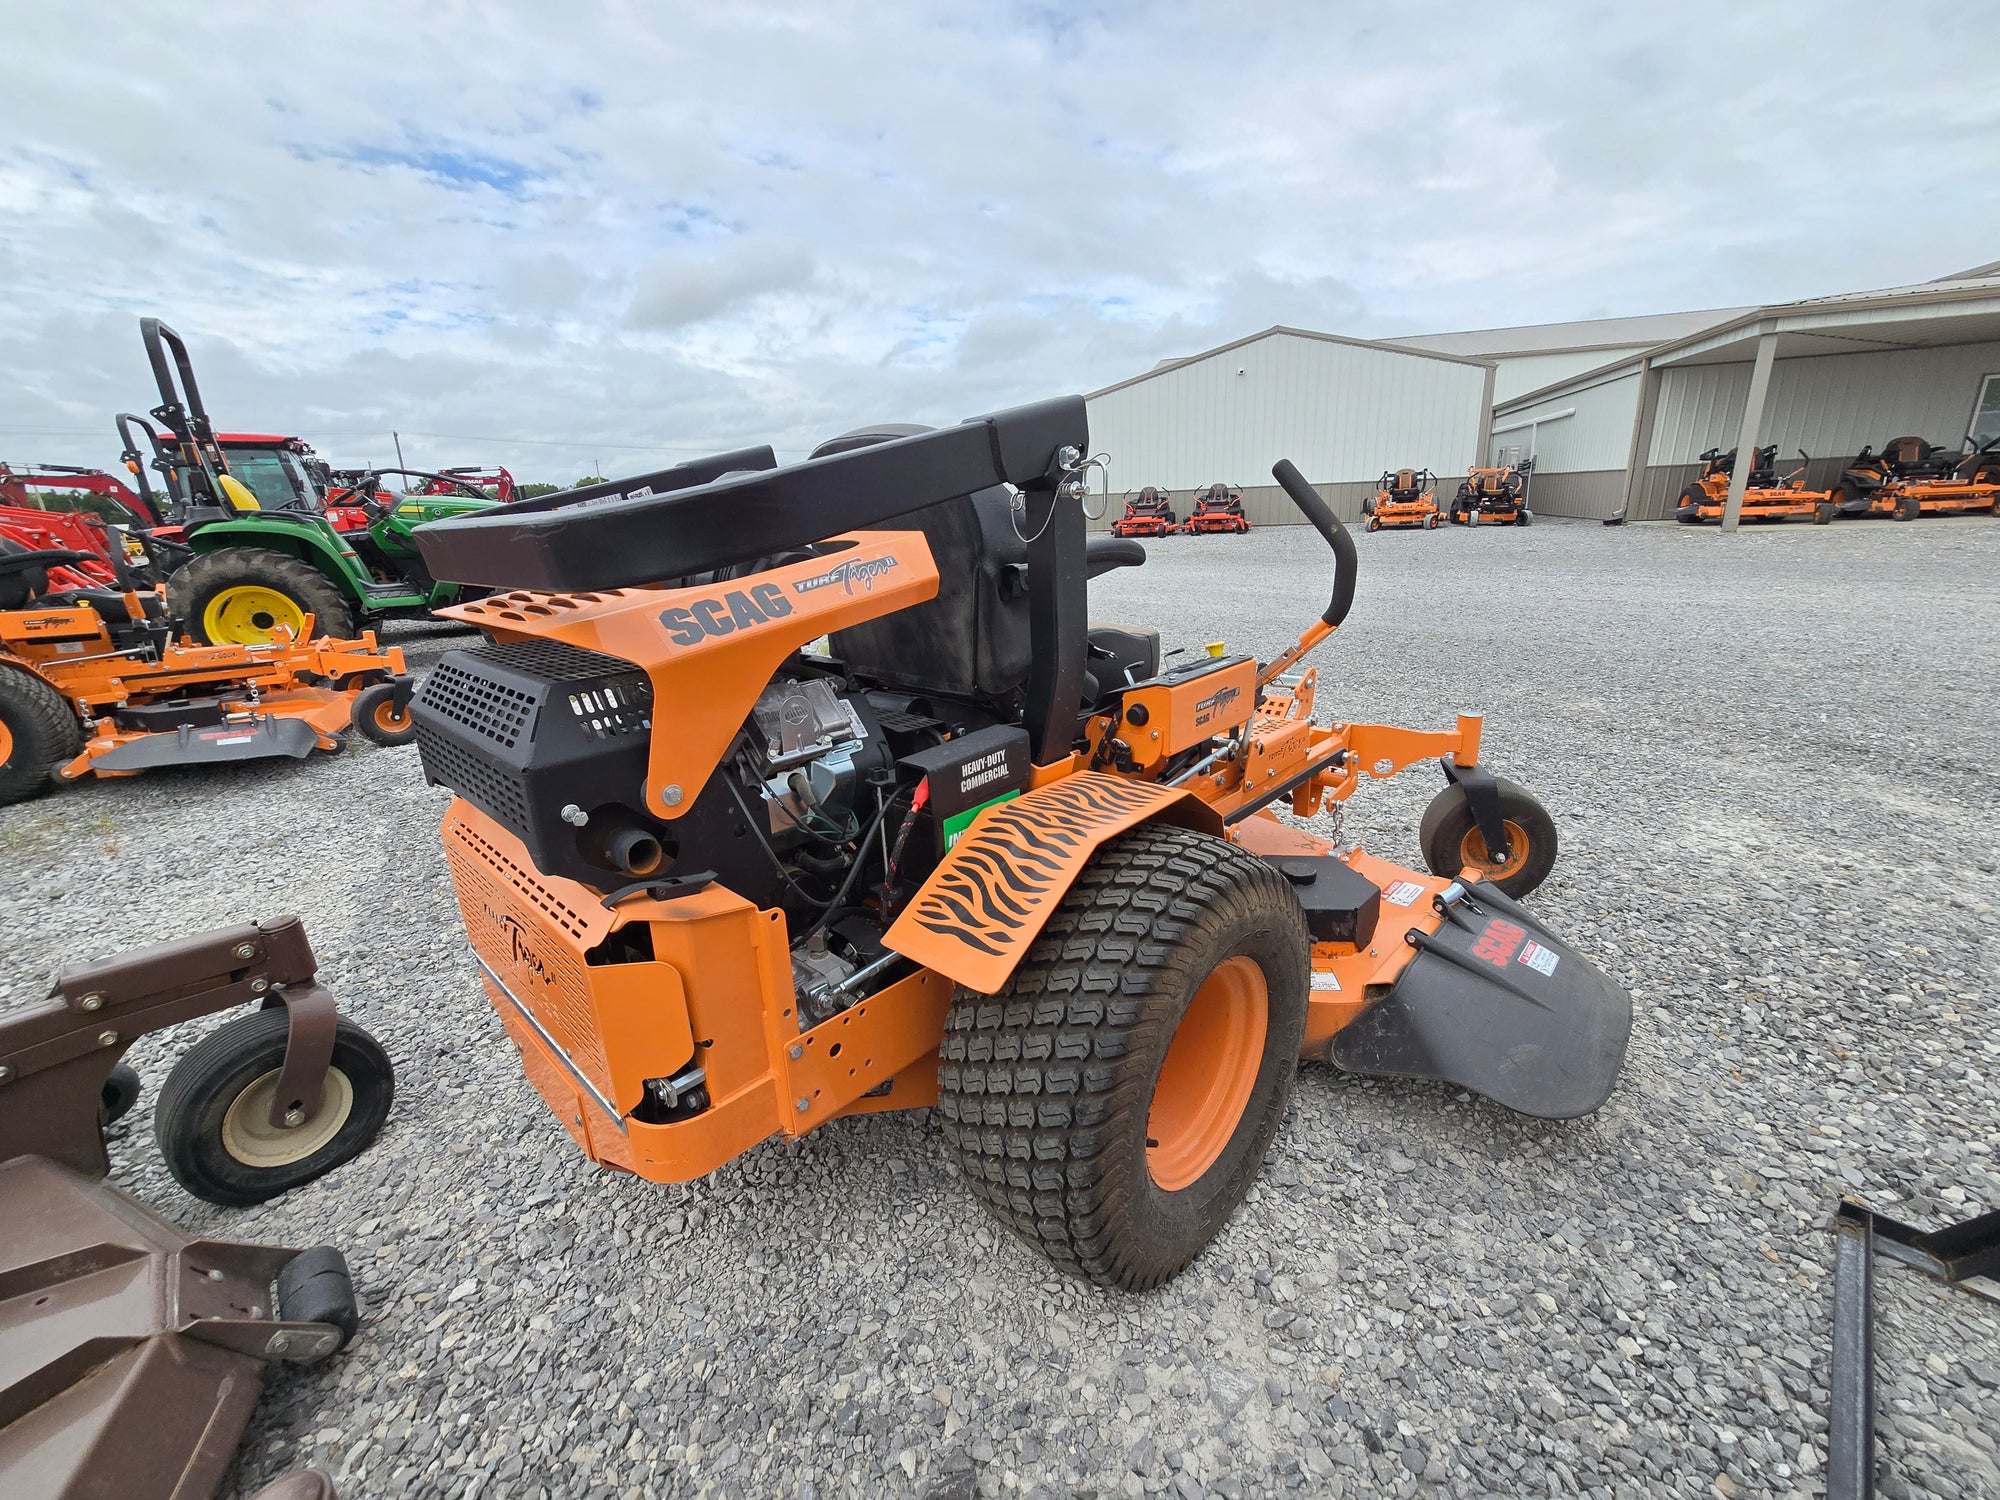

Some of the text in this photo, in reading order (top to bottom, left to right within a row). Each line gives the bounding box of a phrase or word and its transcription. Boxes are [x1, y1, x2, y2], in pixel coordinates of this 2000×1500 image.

[796, 572, 841, 592] TURF
[828, 557, 889, 597] Tiger
[658, 582, 794, 647] SCAG
[1195, 712, 1210, 727] SCAG
[960, 763, 1009, 793] COMMERCIAL
[961, 748, 1006, 778] HEAVY-DUTY
[948, 828, 968, 849] IN
[1472, 918, 1526, 968] SCAG
[1198, 1056, 1293, 1232] CARLISLE
